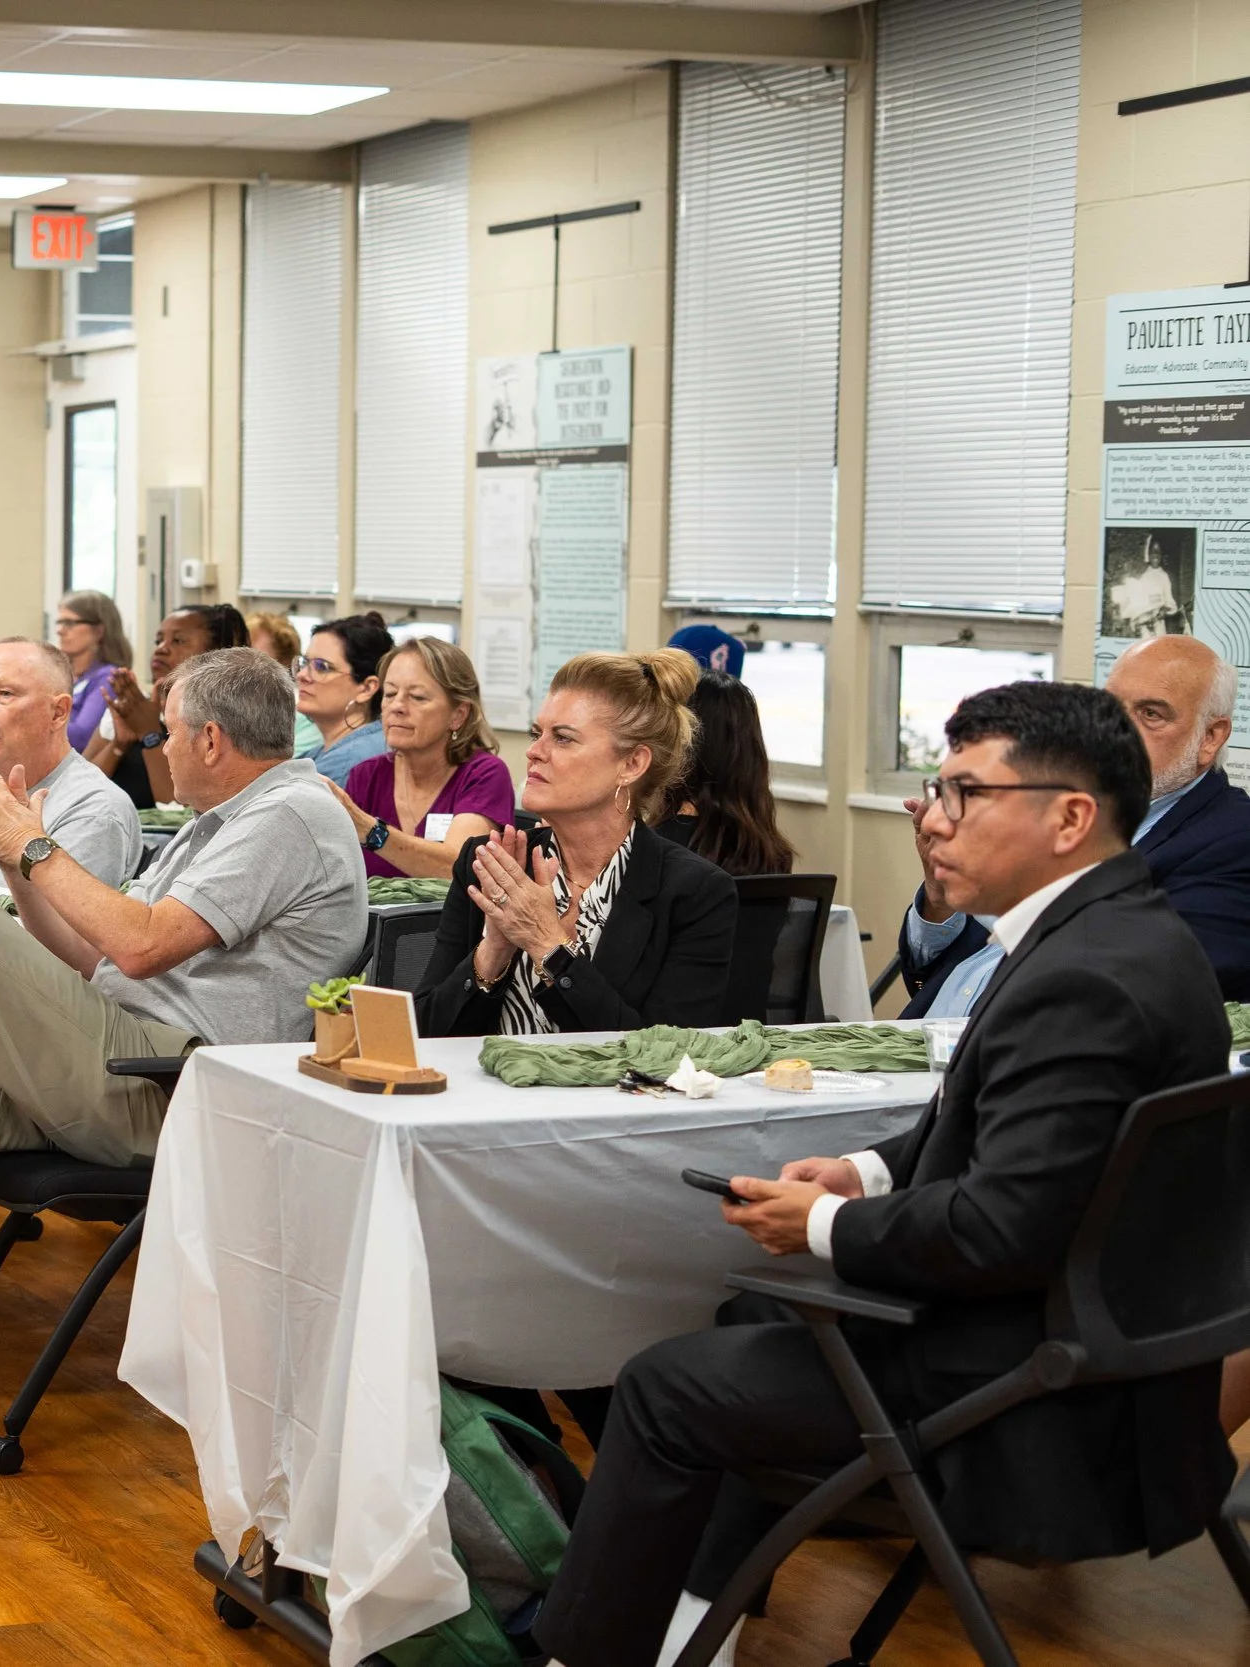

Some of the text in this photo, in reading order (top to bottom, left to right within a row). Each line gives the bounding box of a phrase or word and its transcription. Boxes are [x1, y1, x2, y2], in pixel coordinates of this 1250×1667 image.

[32, 214, 86, 261] EXIT
[1127, 316, 1205, 350] PAULETTE
[1125, 357, 1248, 375] Educator, Advocate, Community
